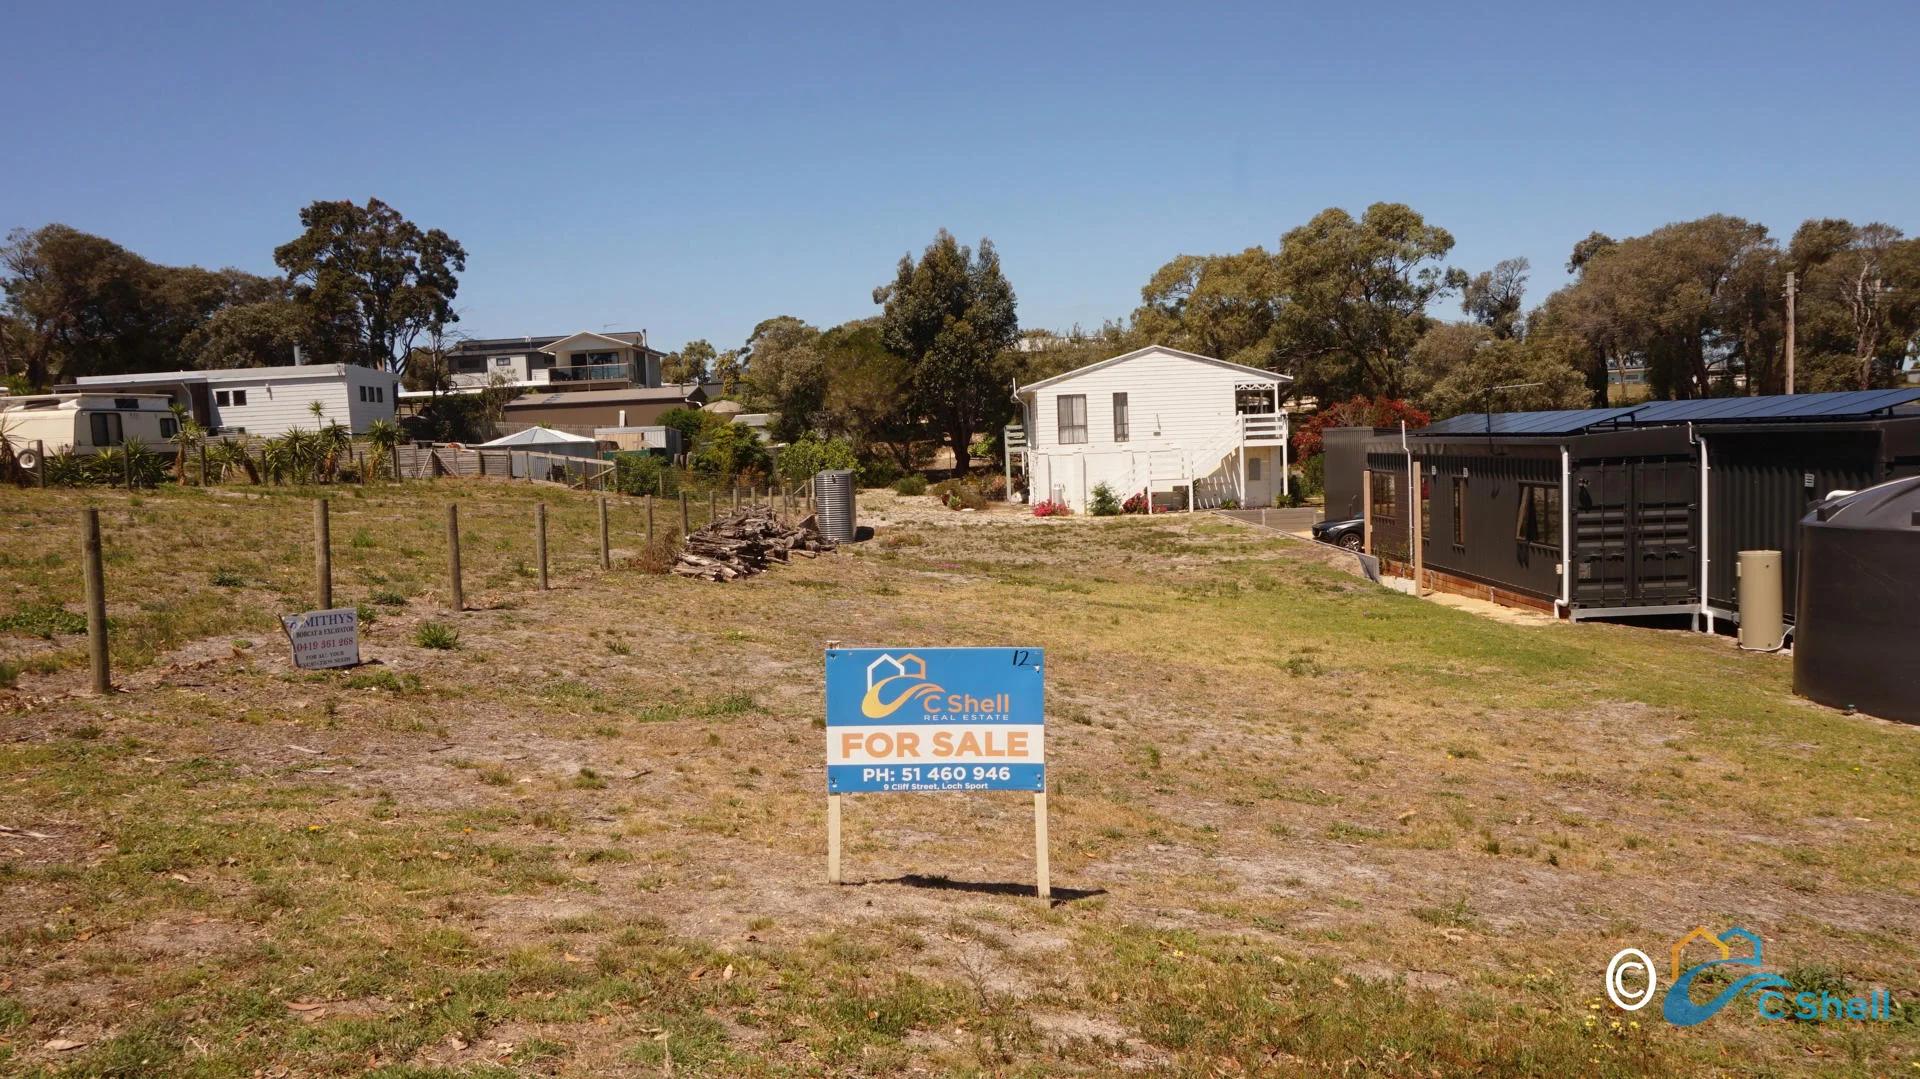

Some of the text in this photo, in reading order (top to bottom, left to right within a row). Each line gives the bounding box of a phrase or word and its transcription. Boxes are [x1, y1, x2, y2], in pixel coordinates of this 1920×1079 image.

[324, 626, 354, 635] EXCAVATOR
[296, 641, 318, 652] 0419
[1012, 650, 1029, 667] 12
[923, 693, 1009, 713] C Shell
[962, 713, 1009, 721] ESTATE
[841, 731, 1029, 759] FOR SALE
[863, 766, 1011, 782] PH: 51 460 946
[883, 783, 889, 791] 9
[891, 782, 909, 791] Cliff
[941, 781, 963, 790] Loch
[965, 782, 989, 791] Sport
